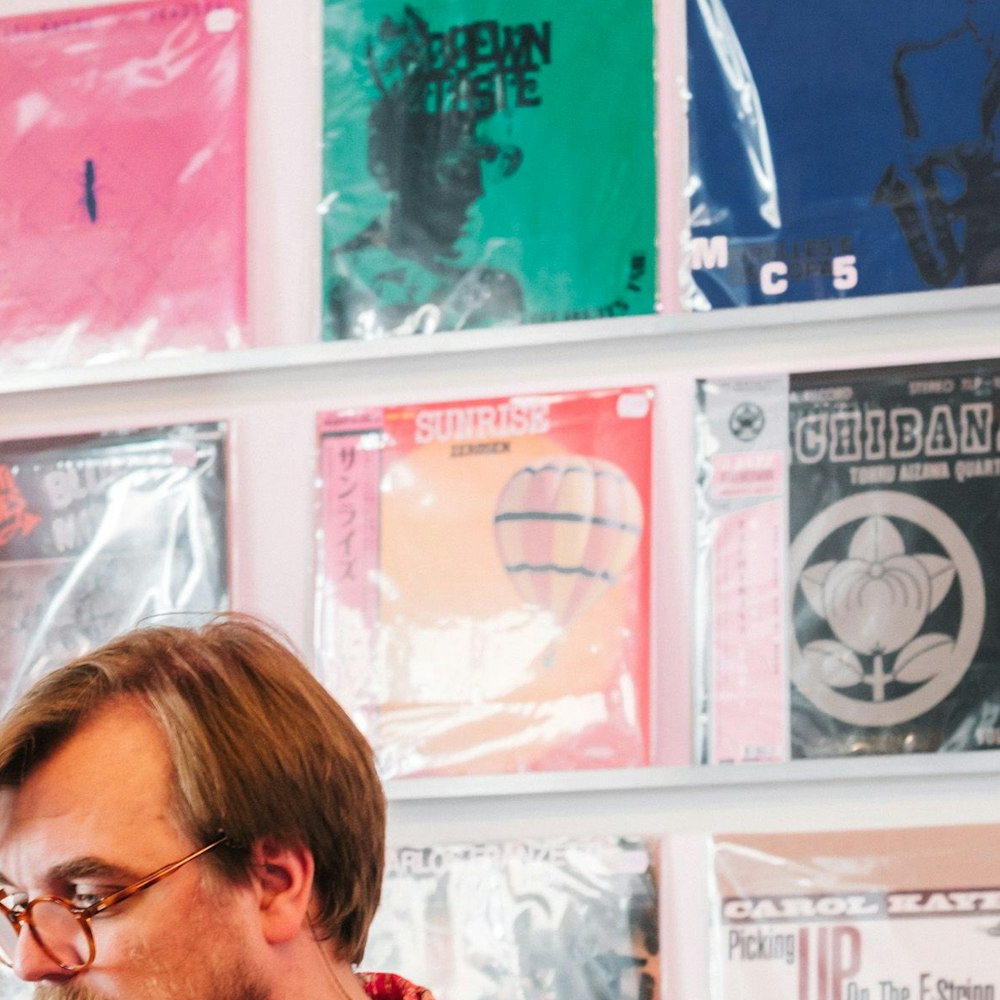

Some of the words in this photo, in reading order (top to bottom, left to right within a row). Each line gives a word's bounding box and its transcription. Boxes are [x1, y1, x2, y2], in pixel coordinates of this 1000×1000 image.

[832, 254, 858, 291] 5
[414, 403, 551, 445] SUNRISE
[790, 402, 1000, 465] CHIBAN
[724, 896, 879, 921] CAROL
[728, 929, 795, 965] Picking
